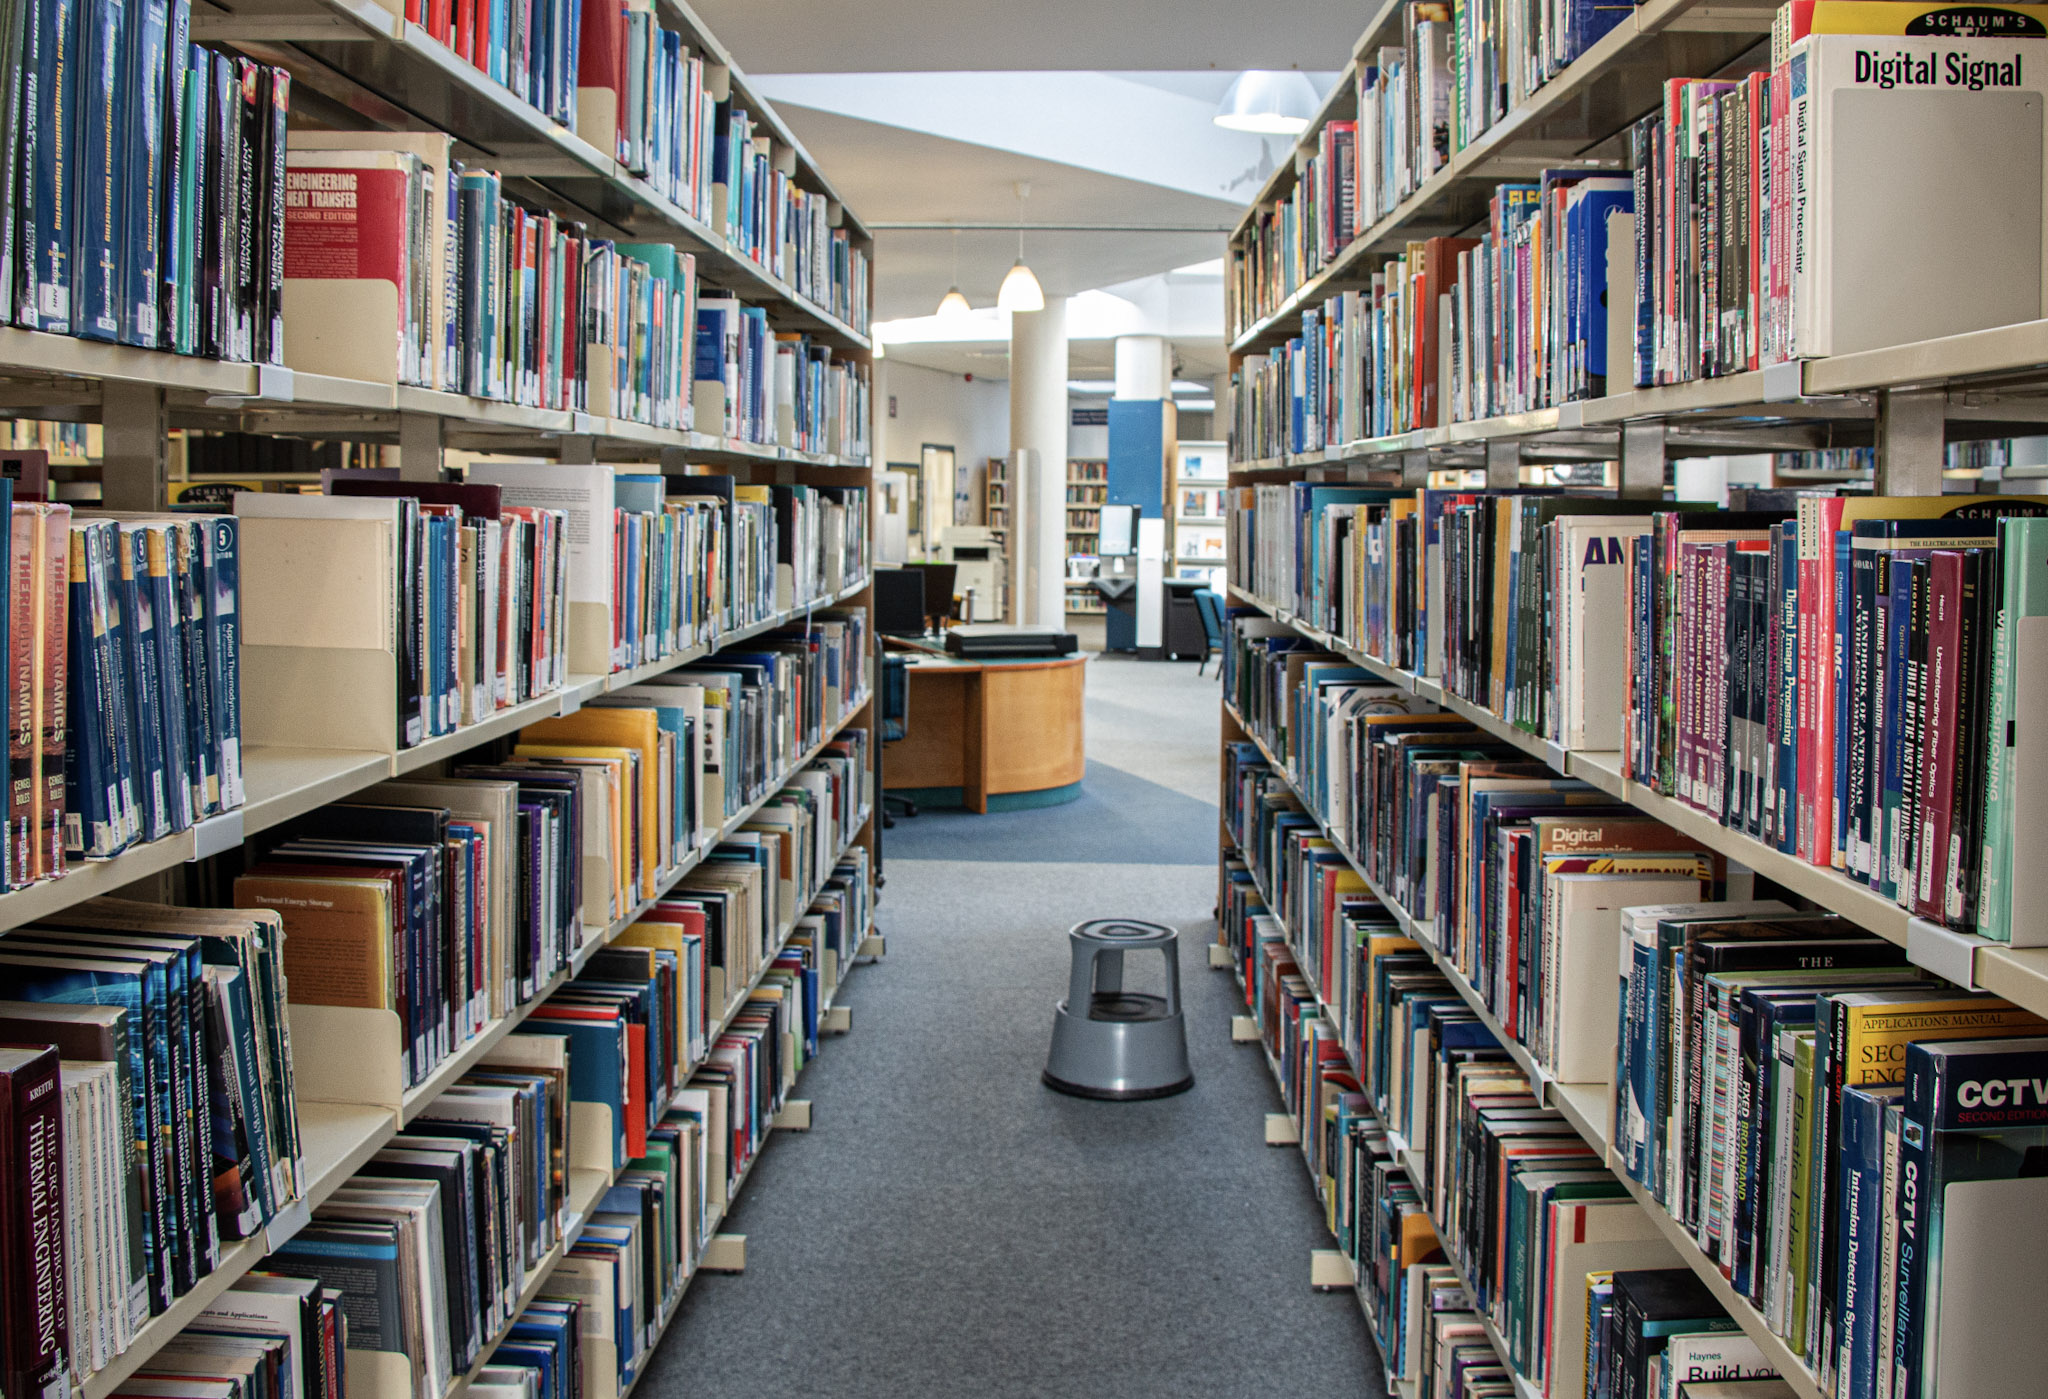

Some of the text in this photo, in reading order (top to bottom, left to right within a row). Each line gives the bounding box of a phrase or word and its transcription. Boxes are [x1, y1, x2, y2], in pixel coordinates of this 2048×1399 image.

[1926, 15, 2026, 28] SCHAUM'S
[54, 3, 66, 230] Advanced Thermodynamics Engineering
[1855, 50, 2022, 91] Digital Signal
[104, 81, 114, 242] Thermodynamics Engineering
[286, 172, 357, 191] ENGINEERING
[286, 191, 357, 208] HEAT TRANSFER
[1723, 110, 1733, 247] SIGNALS AND SYSTEMS
[1795, 100, 1807, 274] Digital Signal Processing
[287, 212, 357, 221] SECOND EDITION
[1638, 165, 1647, 304] TELECOMMUNICATIONS
[105, 532, 111, 548] 5
[138, 540, 145, 556] 5
[219, 530, 226, 546] 5
[19, 552, 31, 745] THERMODYNAMICS
[54, 555, 65, 742] THERMODYNAMICS
[225, 623, 236, 738] Applied Thermodynamics
[1703, 556, 1713, 740] Digital Signal Processing
[1783, 588, 1796, 746] Digital Image Processing
[1834, 633, 1843, 679] EMC
[1874, 606, 1885, 728] ANTENNAS PROPAGATION
[106, 687, 118, 774] Thermodynamics
[200, 665, 211, 744] Thermodynamics
[1856, 610, 1869, 804] HANDBOOK OF ANTENNAS
[1901, 660, 1918, 841] FIBER OPTIC INSTALLATIONS
[1928, 646, 1943, 798] Understanding Fiber Optics
[1990, 609, 2006, 801] WIRELESS POSITIONING
[16, 792, 30, 805] BOLES
[50, 788, 63, 800] BOLES
[1552, 828, 1602, 846] Digital
[255, 896, 334, 908] Thermal Energy Storage
[1799, 956, 1834, 967] THE
[1691, 982, 1704, 1105] MOBILE COMMUNICATIONS
[1708, 1015, 1716, 1050] Mobile
[1864, 1014, 2004, 1030] APPLICATIONS MANUAL
[29, 1078, 54, 1102] KREITH
[195, 1031, 211, 1212] ENGINEERING THERMODYNAMICS
[242, 1028, 261, 1133] Thermal Energy
[1958, 1111, 2005, 1123] SECOND
[1738, 1080, 1751, 1201] FIXED BROADBAND
[1789, 1092, 1804, 1257] Elastic Lidar
[1884, 1141, 1896, 1208] PUBLIC
[30, 1115, 55, 1356] THERMAL ENGINEERING
[48, 1118, 66, 1331] THE CRC HANDBOOK OF
[1846, 1170, 1862, 1309] Intrusion Detection
[1894, 1160, 1918, 1367] CCTV Surveillance
[230, 1311, 268, 1320] Applications
[1689, 1352, 1722, 1361] Haynes
[1689, 1364, 1740, 1381] Build
